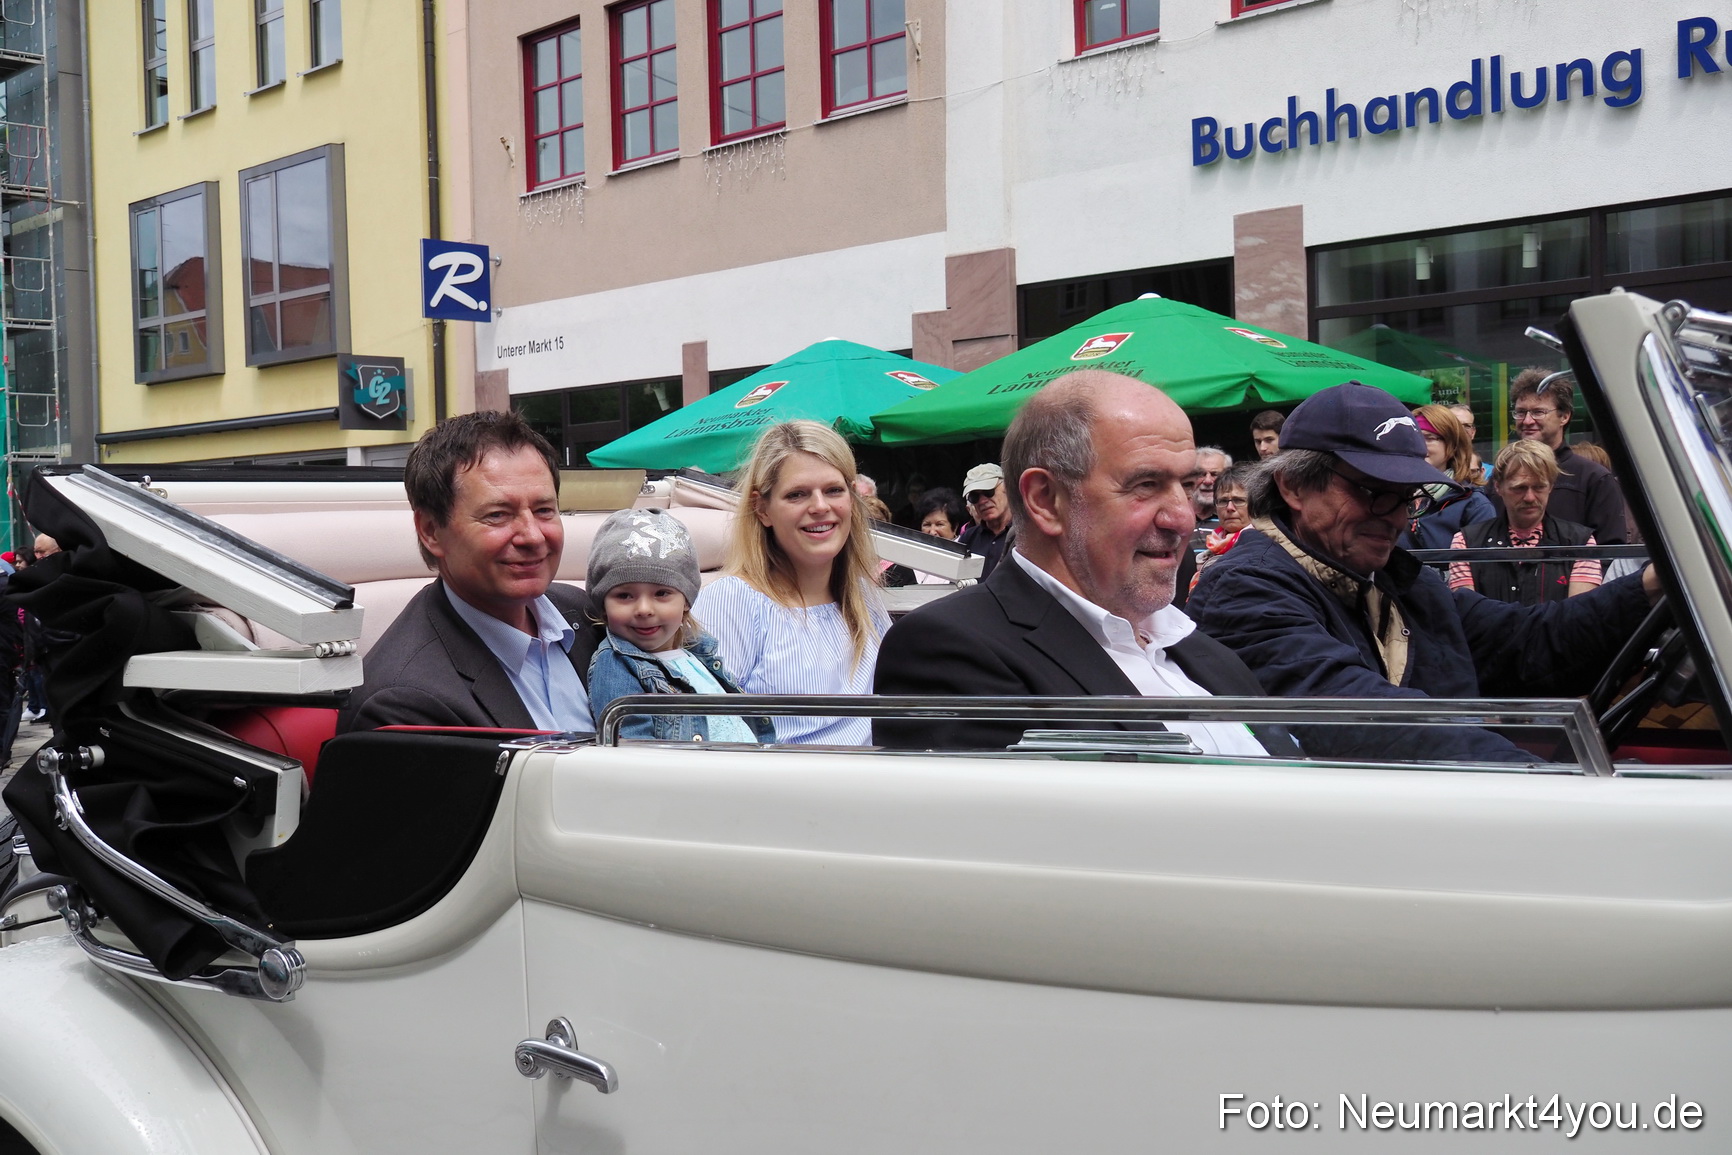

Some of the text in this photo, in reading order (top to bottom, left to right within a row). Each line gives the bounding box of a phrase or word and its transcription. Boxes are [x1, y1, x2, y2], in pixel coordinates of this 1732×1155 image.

[1191, 16, 1732, 167] Buchhandlung R
[497, 336, 564, 359] Unterer Markt 15
[1021, 360, 1136, 380] Neumarkter
[368, 375, 392, 405] G2
